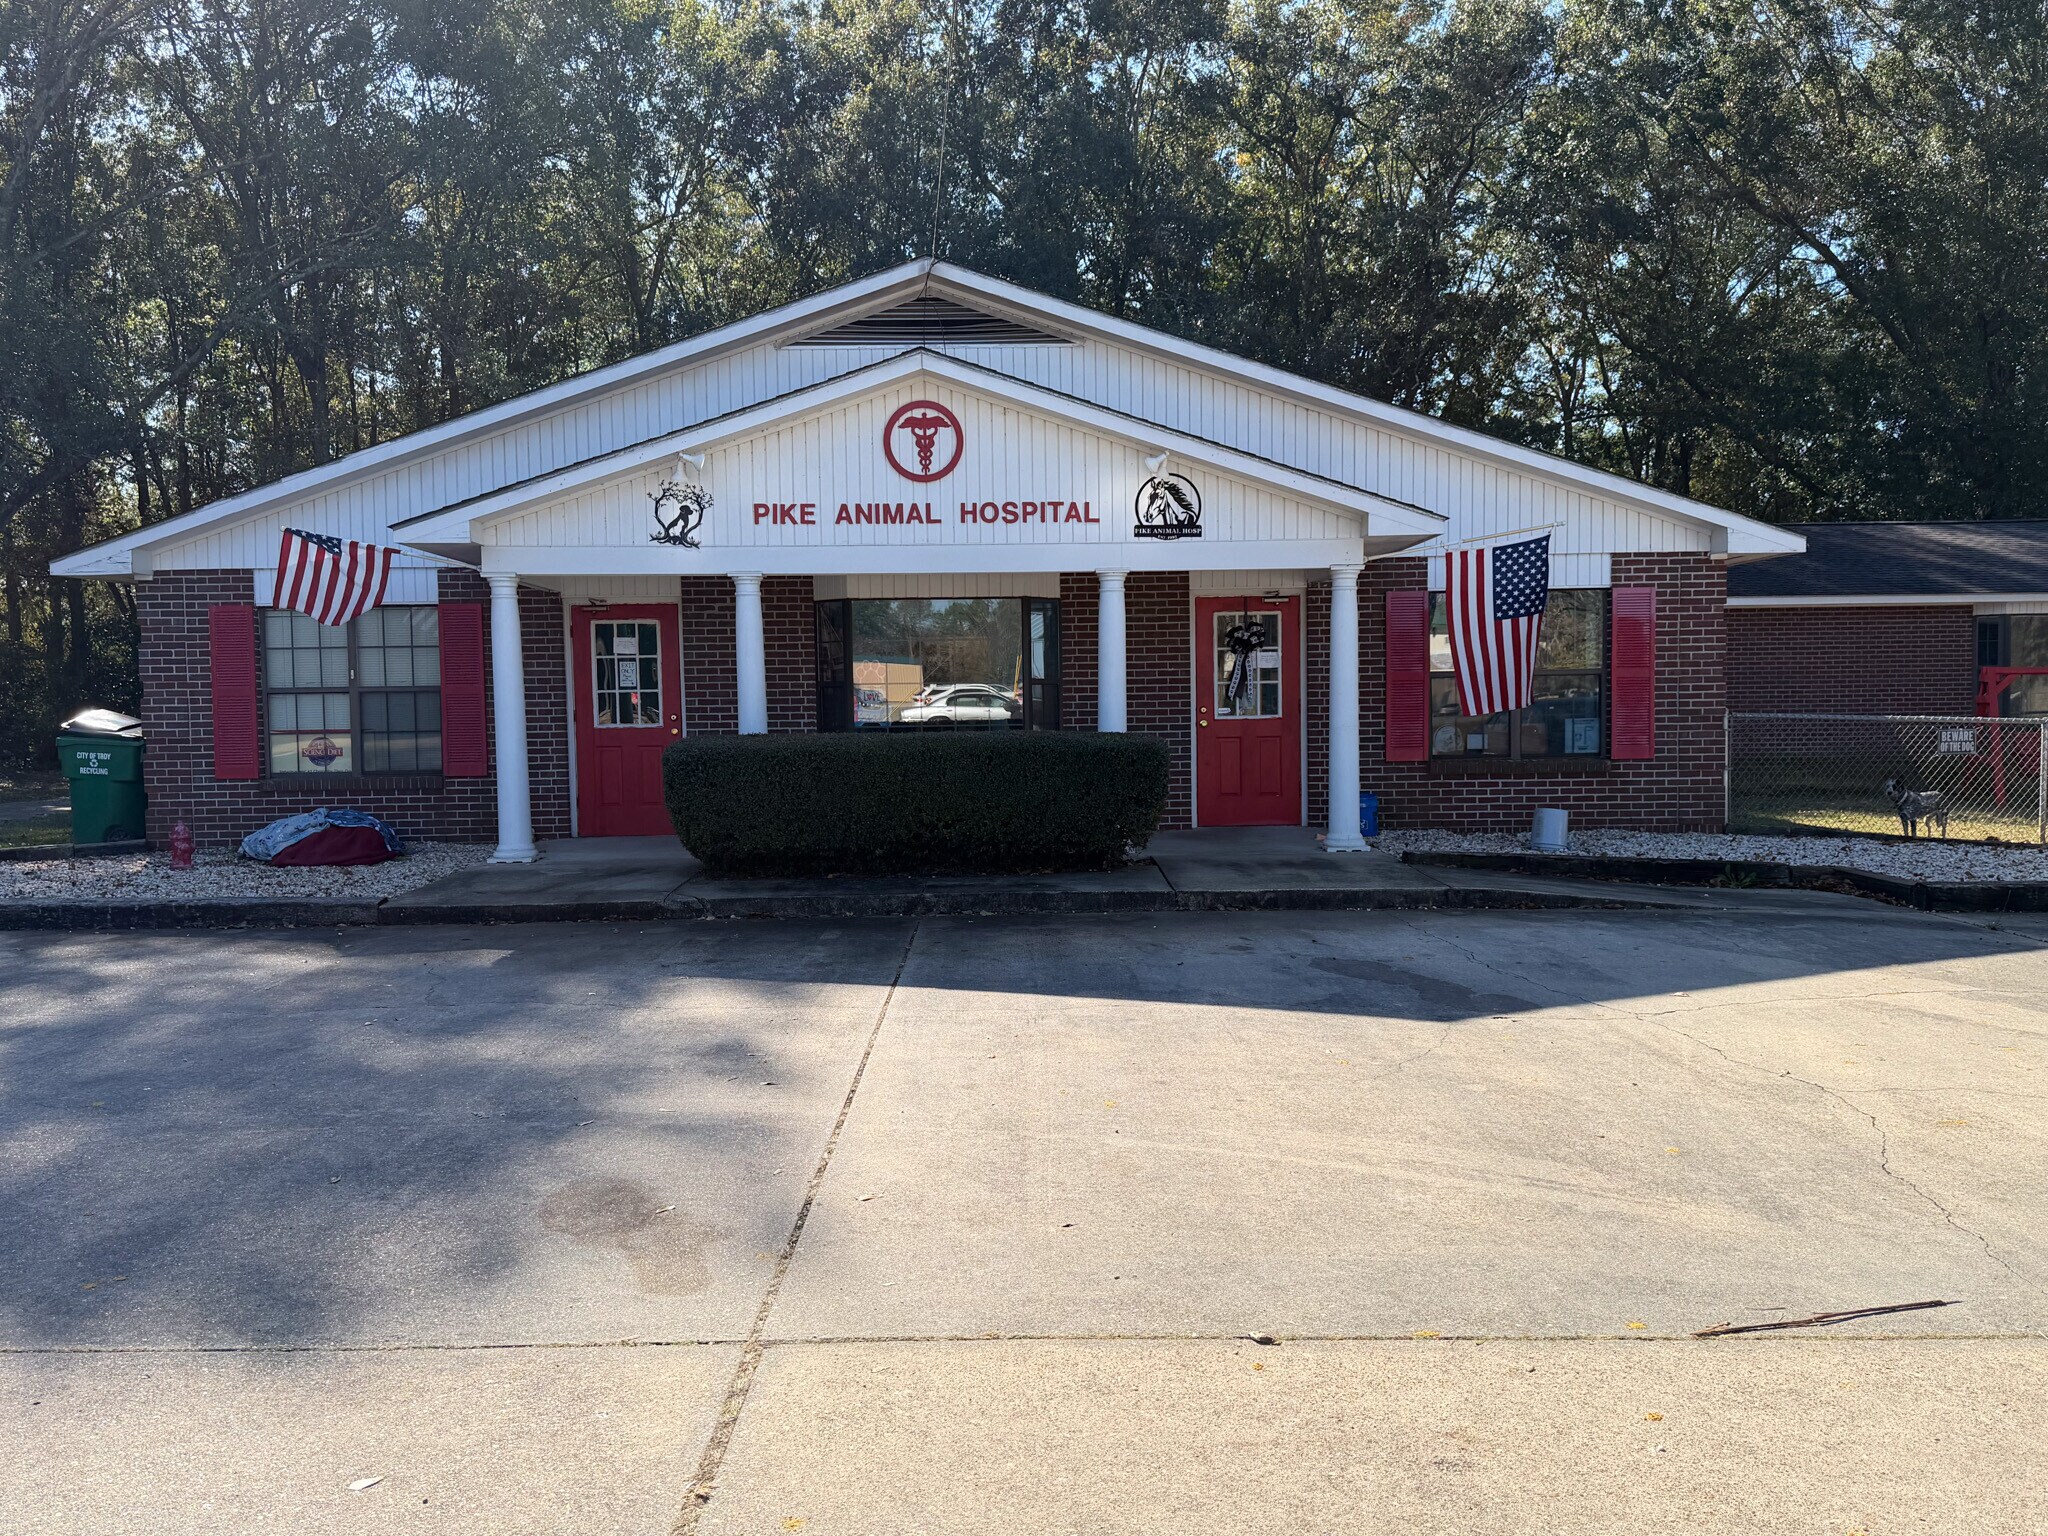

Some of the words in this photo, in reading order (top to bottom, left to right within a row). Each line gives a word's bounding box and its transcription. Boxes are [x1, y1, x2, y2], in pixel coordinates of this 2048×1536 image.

[753, 503, 817, 525] PIKE
[835, 503, 942, 525] ANIMAL
[960, 501, 1101, 524] HOSPITAL
[1941, 730, 1974, 741] BEWARE
[1940, 742, 1949, 752] OF
[1949, 741, 1961, 752] THE
[1961, 741, 1975, 752] DOG
[79, 767, 109, 775] RECYCLING
